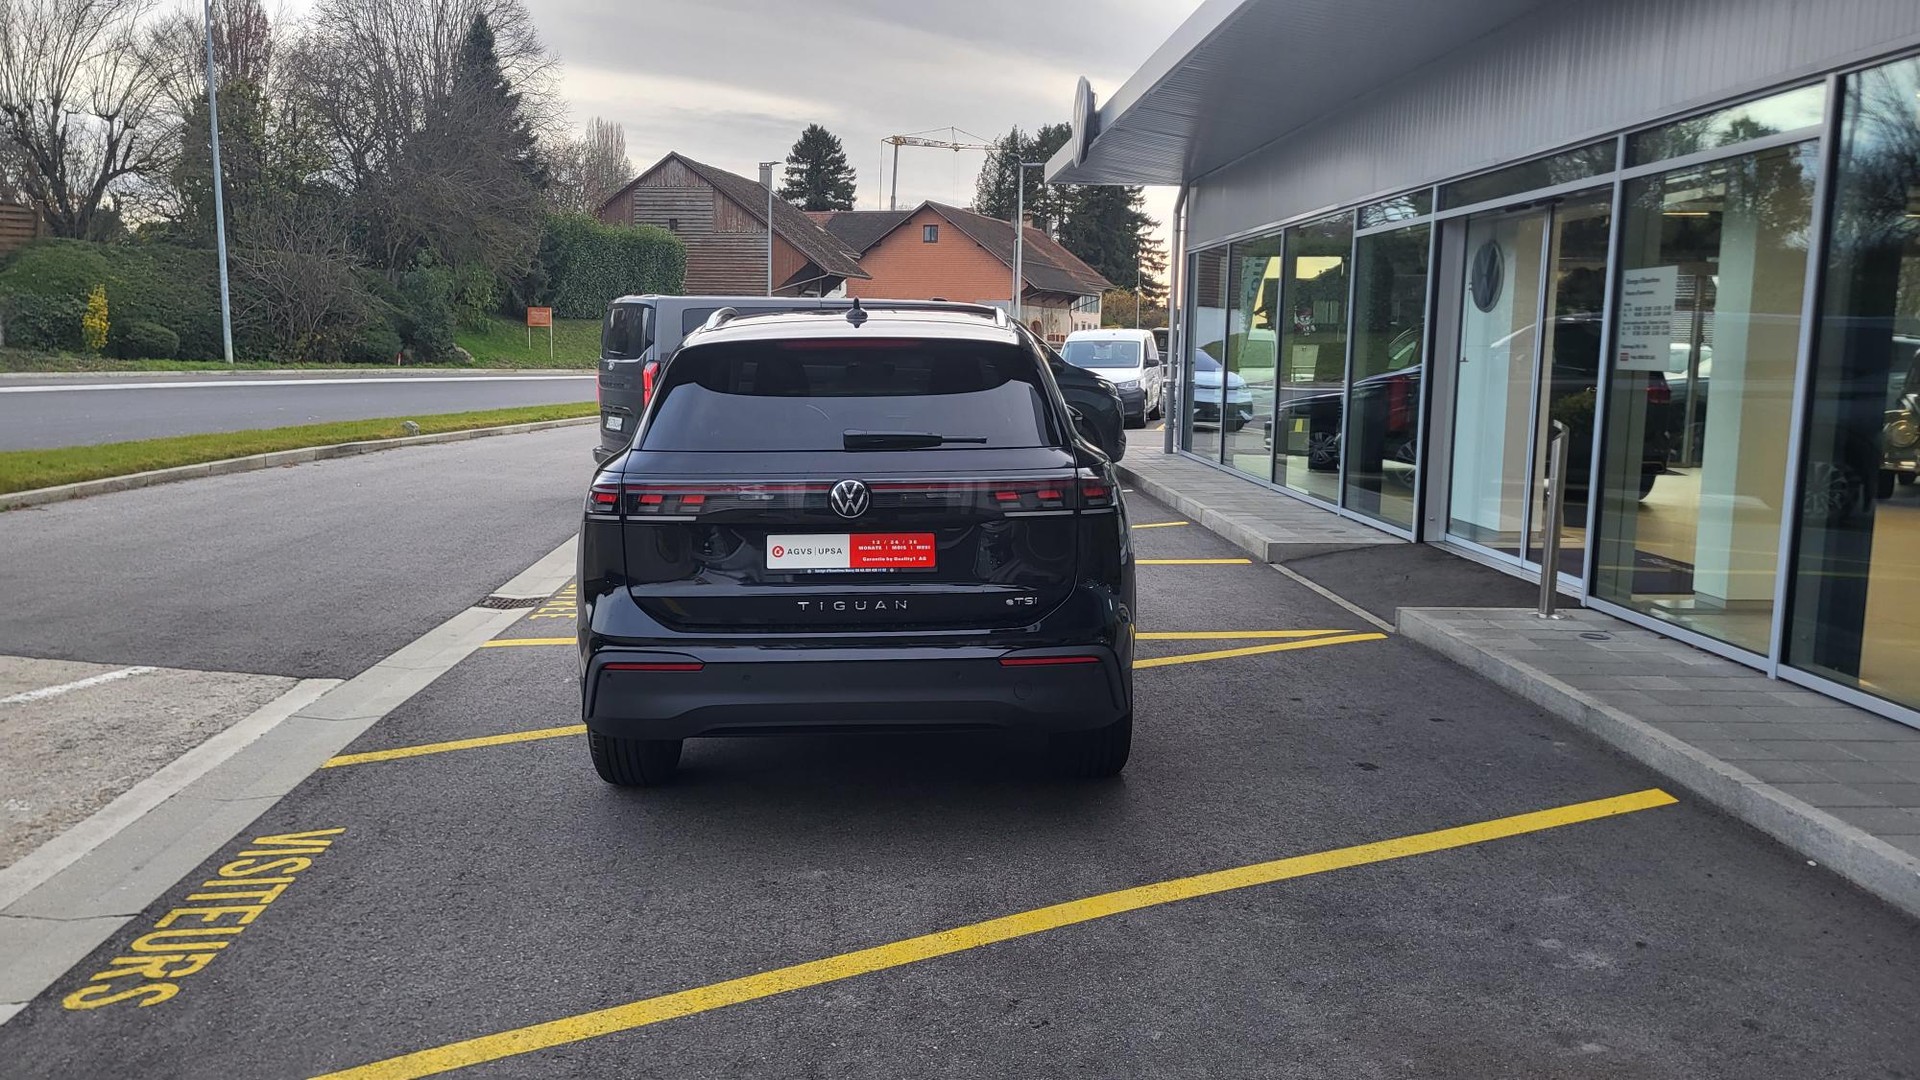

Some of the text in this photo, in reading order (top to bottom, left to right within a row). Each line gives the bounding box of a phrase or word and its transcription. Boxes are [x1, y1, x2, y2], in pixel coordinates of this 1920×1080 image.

[818, 547, 843, 555] UPSA
[797, 600, 908, 611] TIGUAN
[62, 827, 347, 1011] VISITEURS
